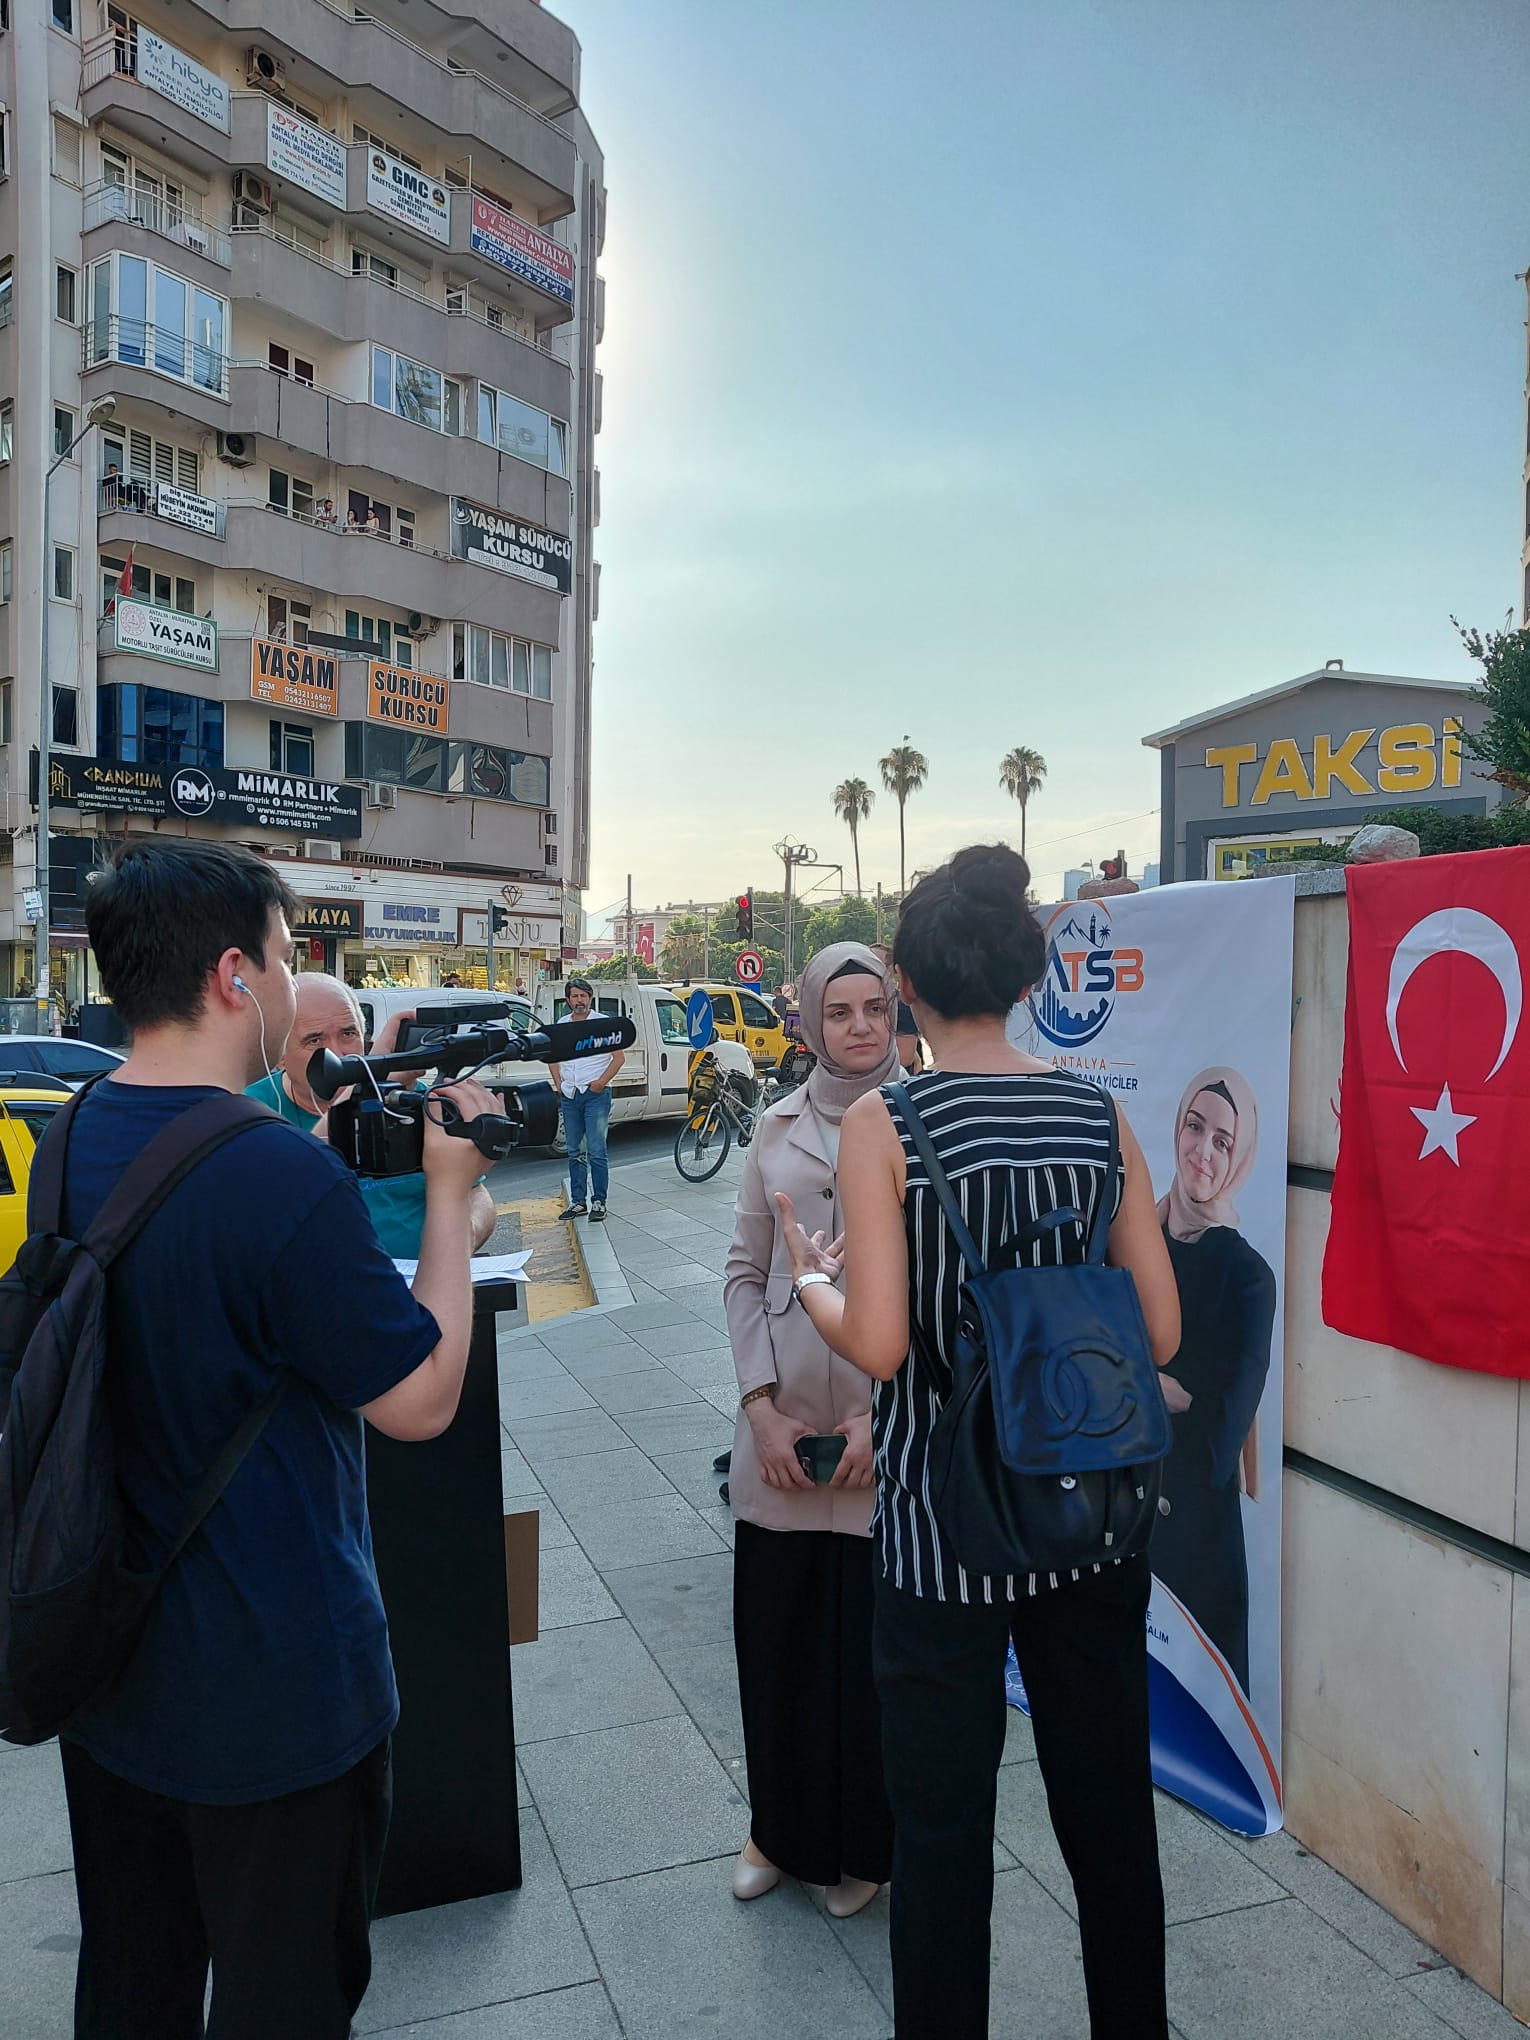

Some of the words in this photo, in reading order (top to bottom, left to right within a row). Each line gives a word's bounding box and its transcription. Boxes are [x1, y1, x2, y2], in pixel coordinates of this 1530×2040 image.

[145, 70, 174, 91] ANTALYA
[153, 65, 182, 86] HABER
[171, 54, 223, 101] hibya
[160, 86, 176, 99] 0505
[179, 97, 190, 107] 774
[272, 124, 298, 144] ANTALYA
[300, 139, 319, 155] TEMPO
[322, 150, 343, 170] DERGİSİ
[272, 131, 292, 147] SOSYAL
[293, 144, 310, 159] MEDYA
[312, 154, 343, 178] REKLAMLARI
[392, 166, 429, 199] GMC
[372, 173, 406, 196] GAZETECİLER
[407, 193, 413, 201] VE
[415, 197, 447, 219] MEDYACILAR
[398, 195, 422, 213] CEMİYETİ
[376, 199, 440, 236] www.gmc.org.tr
[390, 198, 406, 212] GENEL
[407, 207, 429, 224] MERKEZİ
[478, 205, 497, 225] 07
[499, 216, 526, 235] HABER
[476, 228, 504, 249] REKLAM
[510, 248, 530, 262] KAYIP
[487, 225, 558, 270] www.07haber.com.tr
[527, 234, 570, 269] ANTALYA
[478, 245, 507, 263] 0507
[512, 263, 532, 279] 774
[536, 276, 549, 288] 74
[552, 286, 565, 296] 47
[489, 244, 524, 268] WHATSAPP
[526, 265, 545, 280] İHBAR
[548, 277, 565, 291] HATTI
[170, 489, 181, 498] DİŞ
[161, 493, 185, 508] HÜSEYİN
[187, 504, 214, 518] AKDUMAN
[178, 509, 191, 517] 322
[469, 509, 516, 540] YAŞAM
[519, 527, 571, 560] SÜRÜCÜ
[483, 534, 544, 569] KURSU
[149, 609, 168, 619] ANTALYA
[172, 615, 197, 627] MURATPAŞA
[149, 615, 162, 623] ÖZEL
[150, 622, 211, 651] YAŞAM
[122, 636, 148, 649] MOTORLU
[148, 642, 163, 653] TAŞIT
[163, 645, 195, 660] SÜRÜCÜLERİ
[195, 654, 212, 664] KURSU
[257, 643, 334, 690] YAŞAM
[258, 681, 275, 690] GSM
[285, 687, 331, 702] 05432116507
[374, 669, 445, 706] SÜRÜCÜ
[258, 688, 271, 697] TEL
[285, 695, 331, 711] 02423131407
[380, 695, 438, 727] KURSU
[1206, 715, 1465, 808] TAKSİ
[83, 767, 163, 789] GRANDIUM
[77, 792, 116, 802] MÜHENDİSLİK
[96, 785, 117, 793] İNŞAAT
[118, 787, 148, 795] MİMARLIK
[177, 779, 210, 802] RM
[283, 800, 294, 808] RM
[295, 801, 323, 812] Partners
[275, 818, 289, 826] 506
[291, 819, 302, 828] 145
[303, 821, 311, 829] 53
[340, 884, 356, 892] 1997
[294, 908, 351, 926] NKAYA
[383, 903, 440, 923] EMRE
[365, 927, 456, 942] KUYUMCULUK
[575, 1031, 622, 1051] artworld
[1052, 1055, 1106, 1070] ANTALYA
[1146, 1625, 1168, 1645] ALIM
